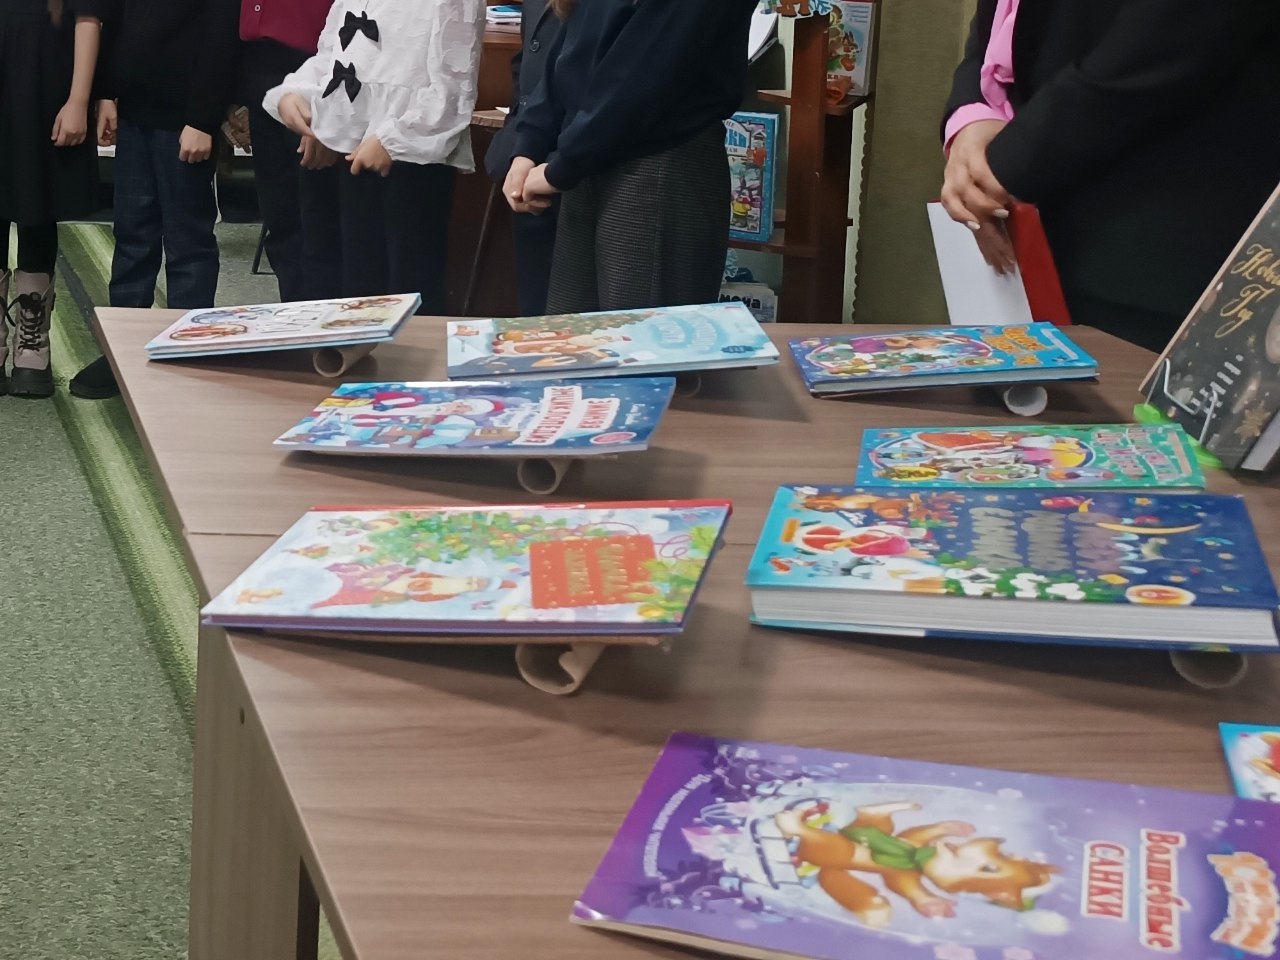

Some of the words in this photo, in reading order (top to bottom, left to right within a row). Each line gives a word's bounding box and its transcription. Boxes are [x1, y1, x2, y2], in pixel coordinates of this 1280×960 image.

[525, 386, 576, 445] ЭНЦИКЛОПЕДИЯ
[576, 398, 613, 430] ЗИМНЯЯ
[1087, 842, 1125, 919] САНКИ
[1144, 830, 1185, 950] Волшебные
